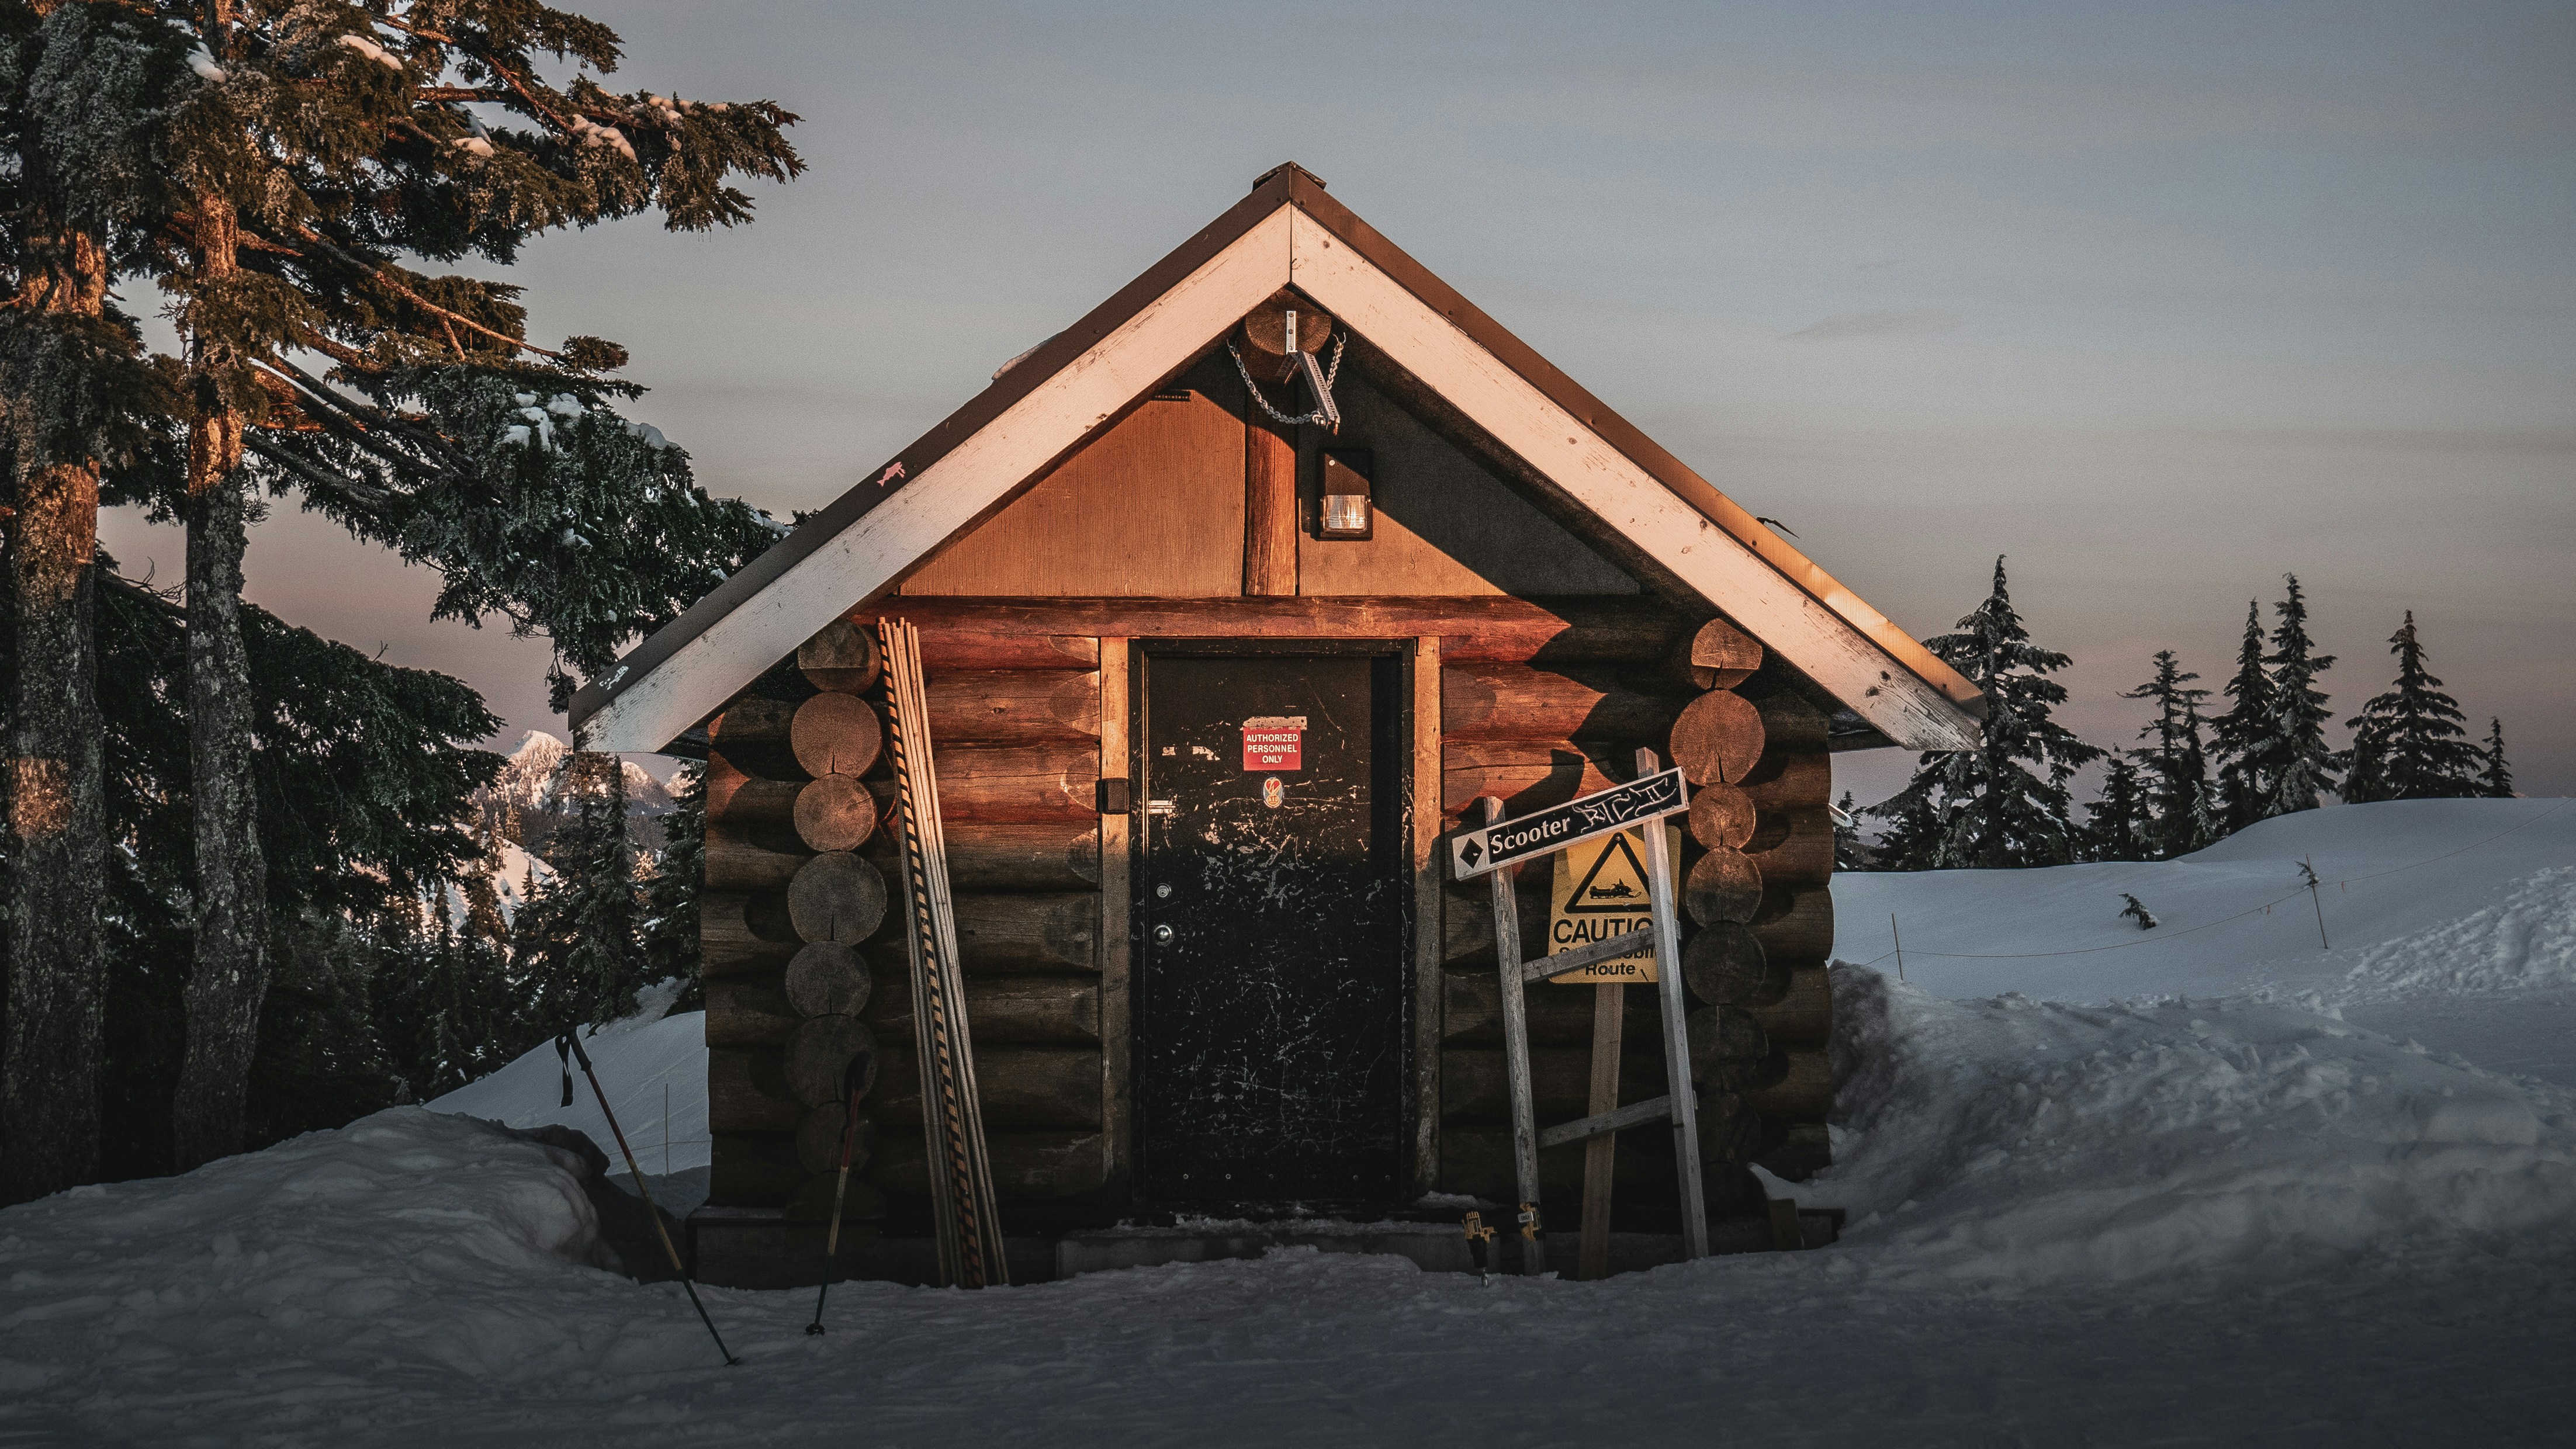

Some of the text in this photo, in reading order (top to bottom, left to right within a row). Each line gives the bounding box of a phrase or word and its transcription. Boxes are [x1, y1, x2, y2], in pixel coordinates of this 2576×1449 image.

[1247, 734, 1299, 742] AUTHORIZED
[1247, 744, 1297, 753] PERSONNEL
[1262, 755, 1283, 763] ONLY
[1491, 817, 1571, 854] Scooter
[1553, 917, 1653, 944] CAUTI
[1585, 962, 1636, 976] Route
